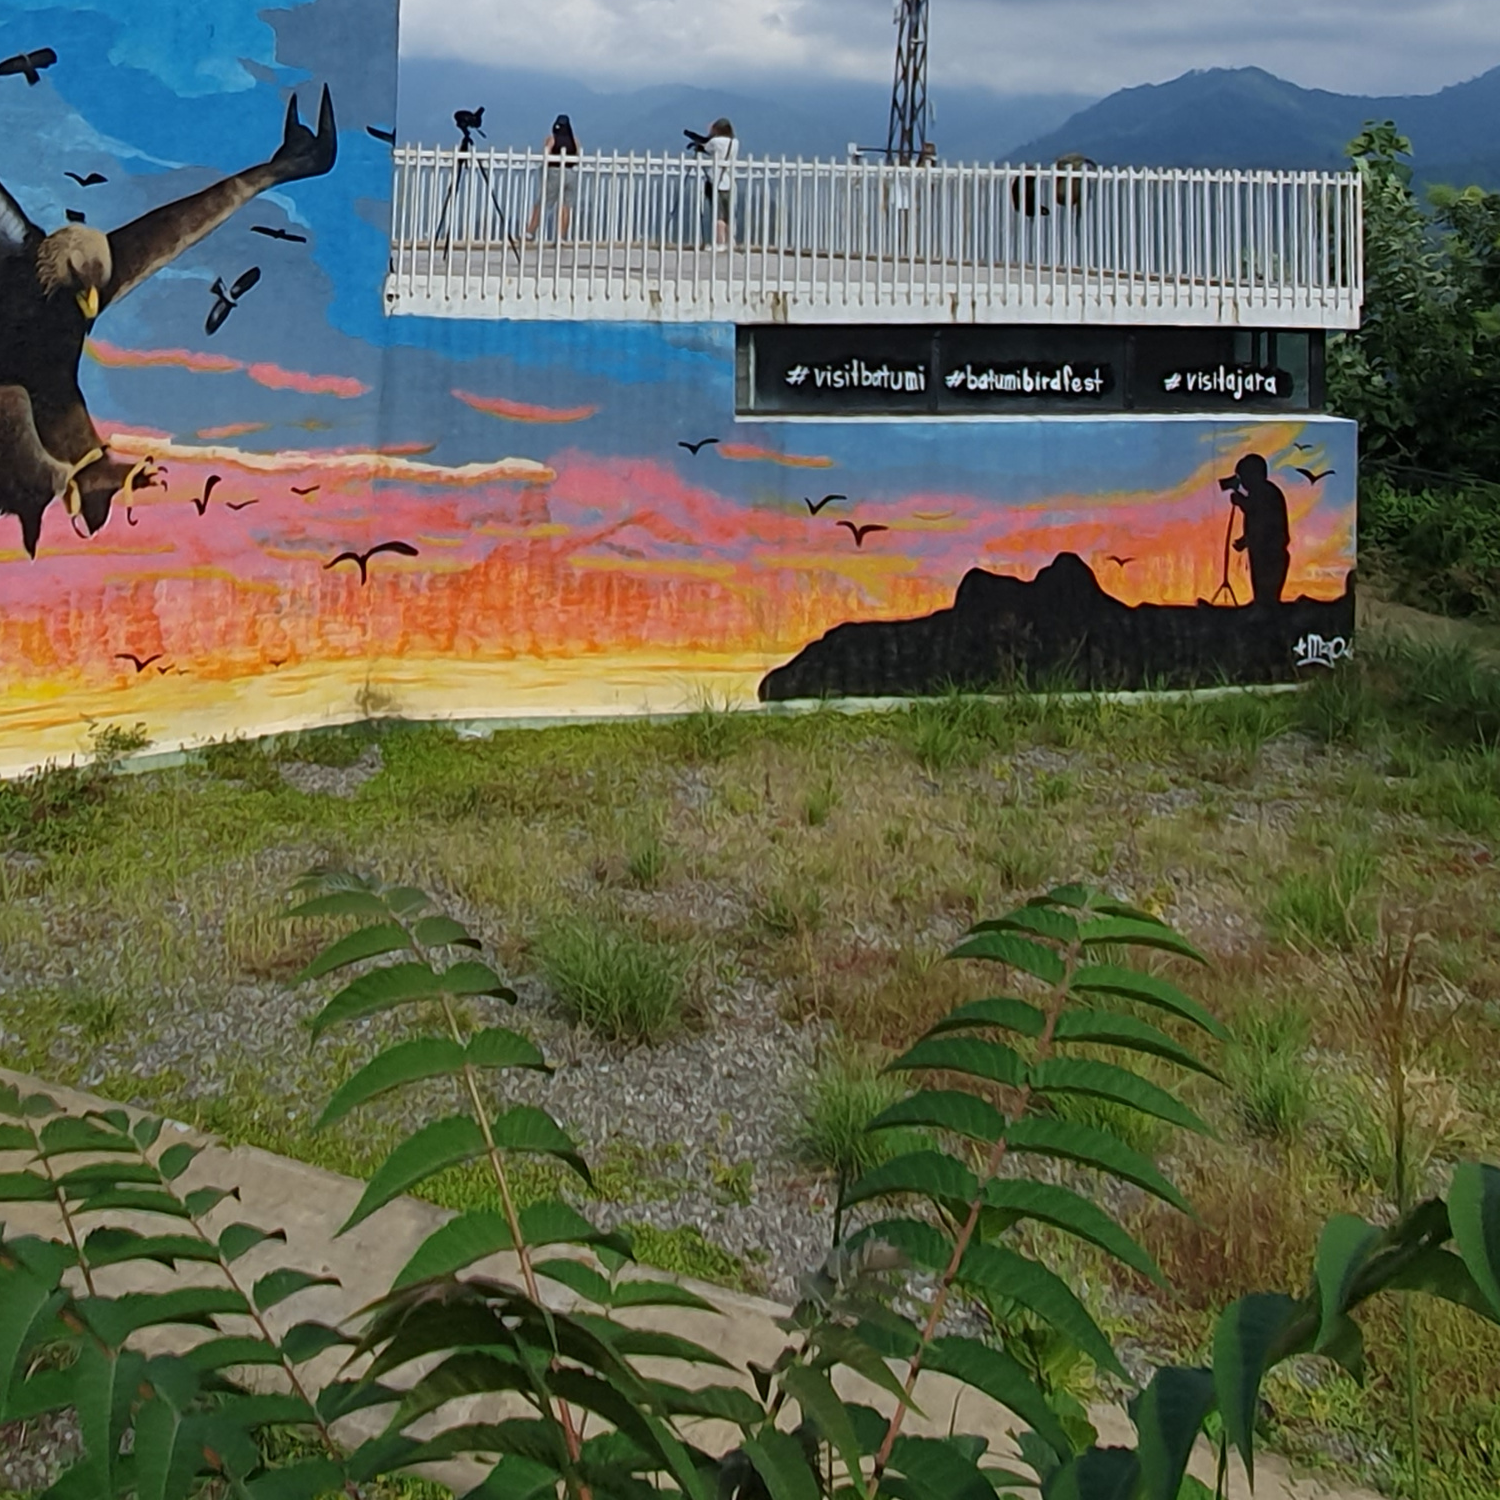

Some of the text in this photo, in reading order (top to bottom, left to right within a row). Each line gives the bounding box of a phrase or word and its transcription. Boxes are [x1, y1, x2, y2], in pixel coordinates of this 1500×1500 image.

[786, 358, 1277, 400] #visitbatumi #batumibirdfest #visitajara
